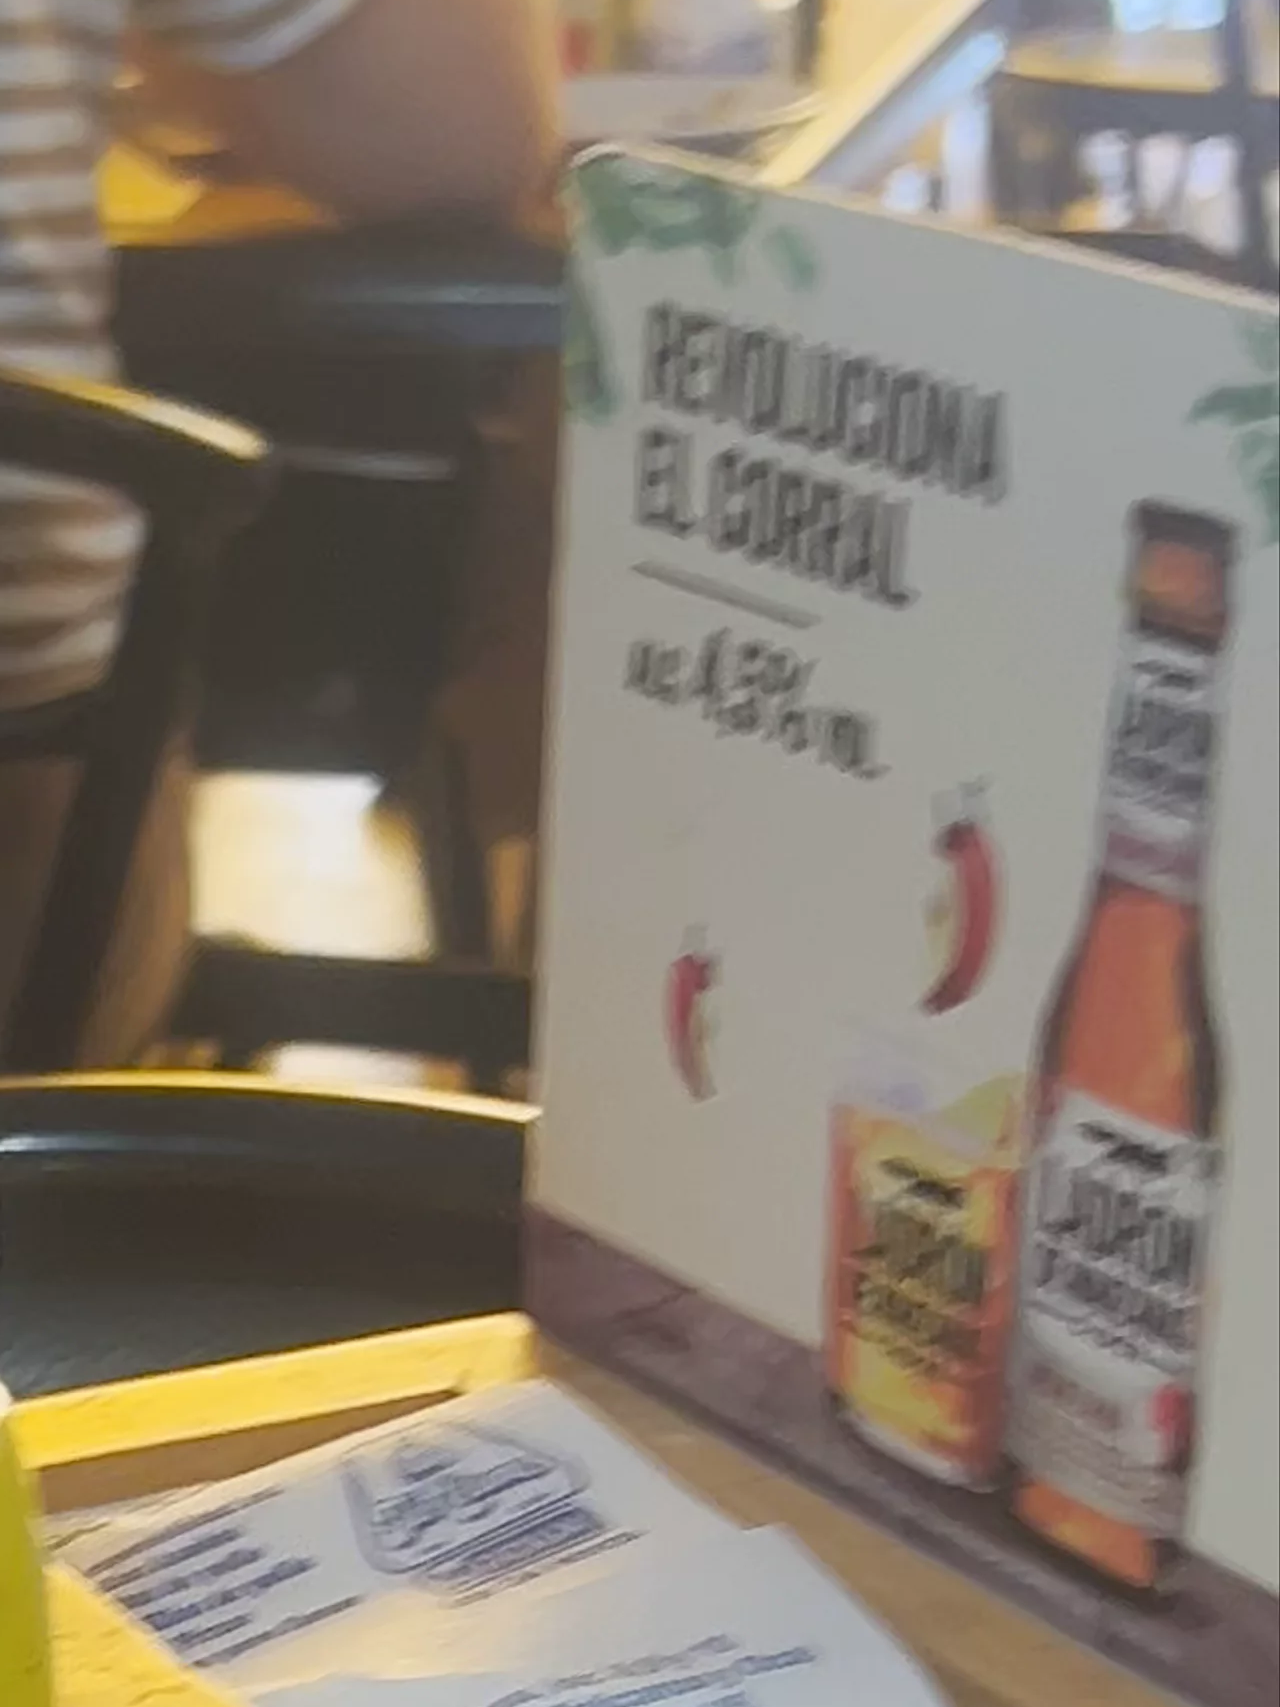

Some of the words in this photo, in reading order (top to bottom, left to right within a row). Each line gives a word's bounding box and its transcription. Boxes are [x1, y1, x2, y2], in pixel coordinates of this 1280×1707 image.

[642, 297, 1008, 508] REVOLUCIONA
[632, 423, 694, 540] EL
[707, 443, 920, 611] CORRAL
